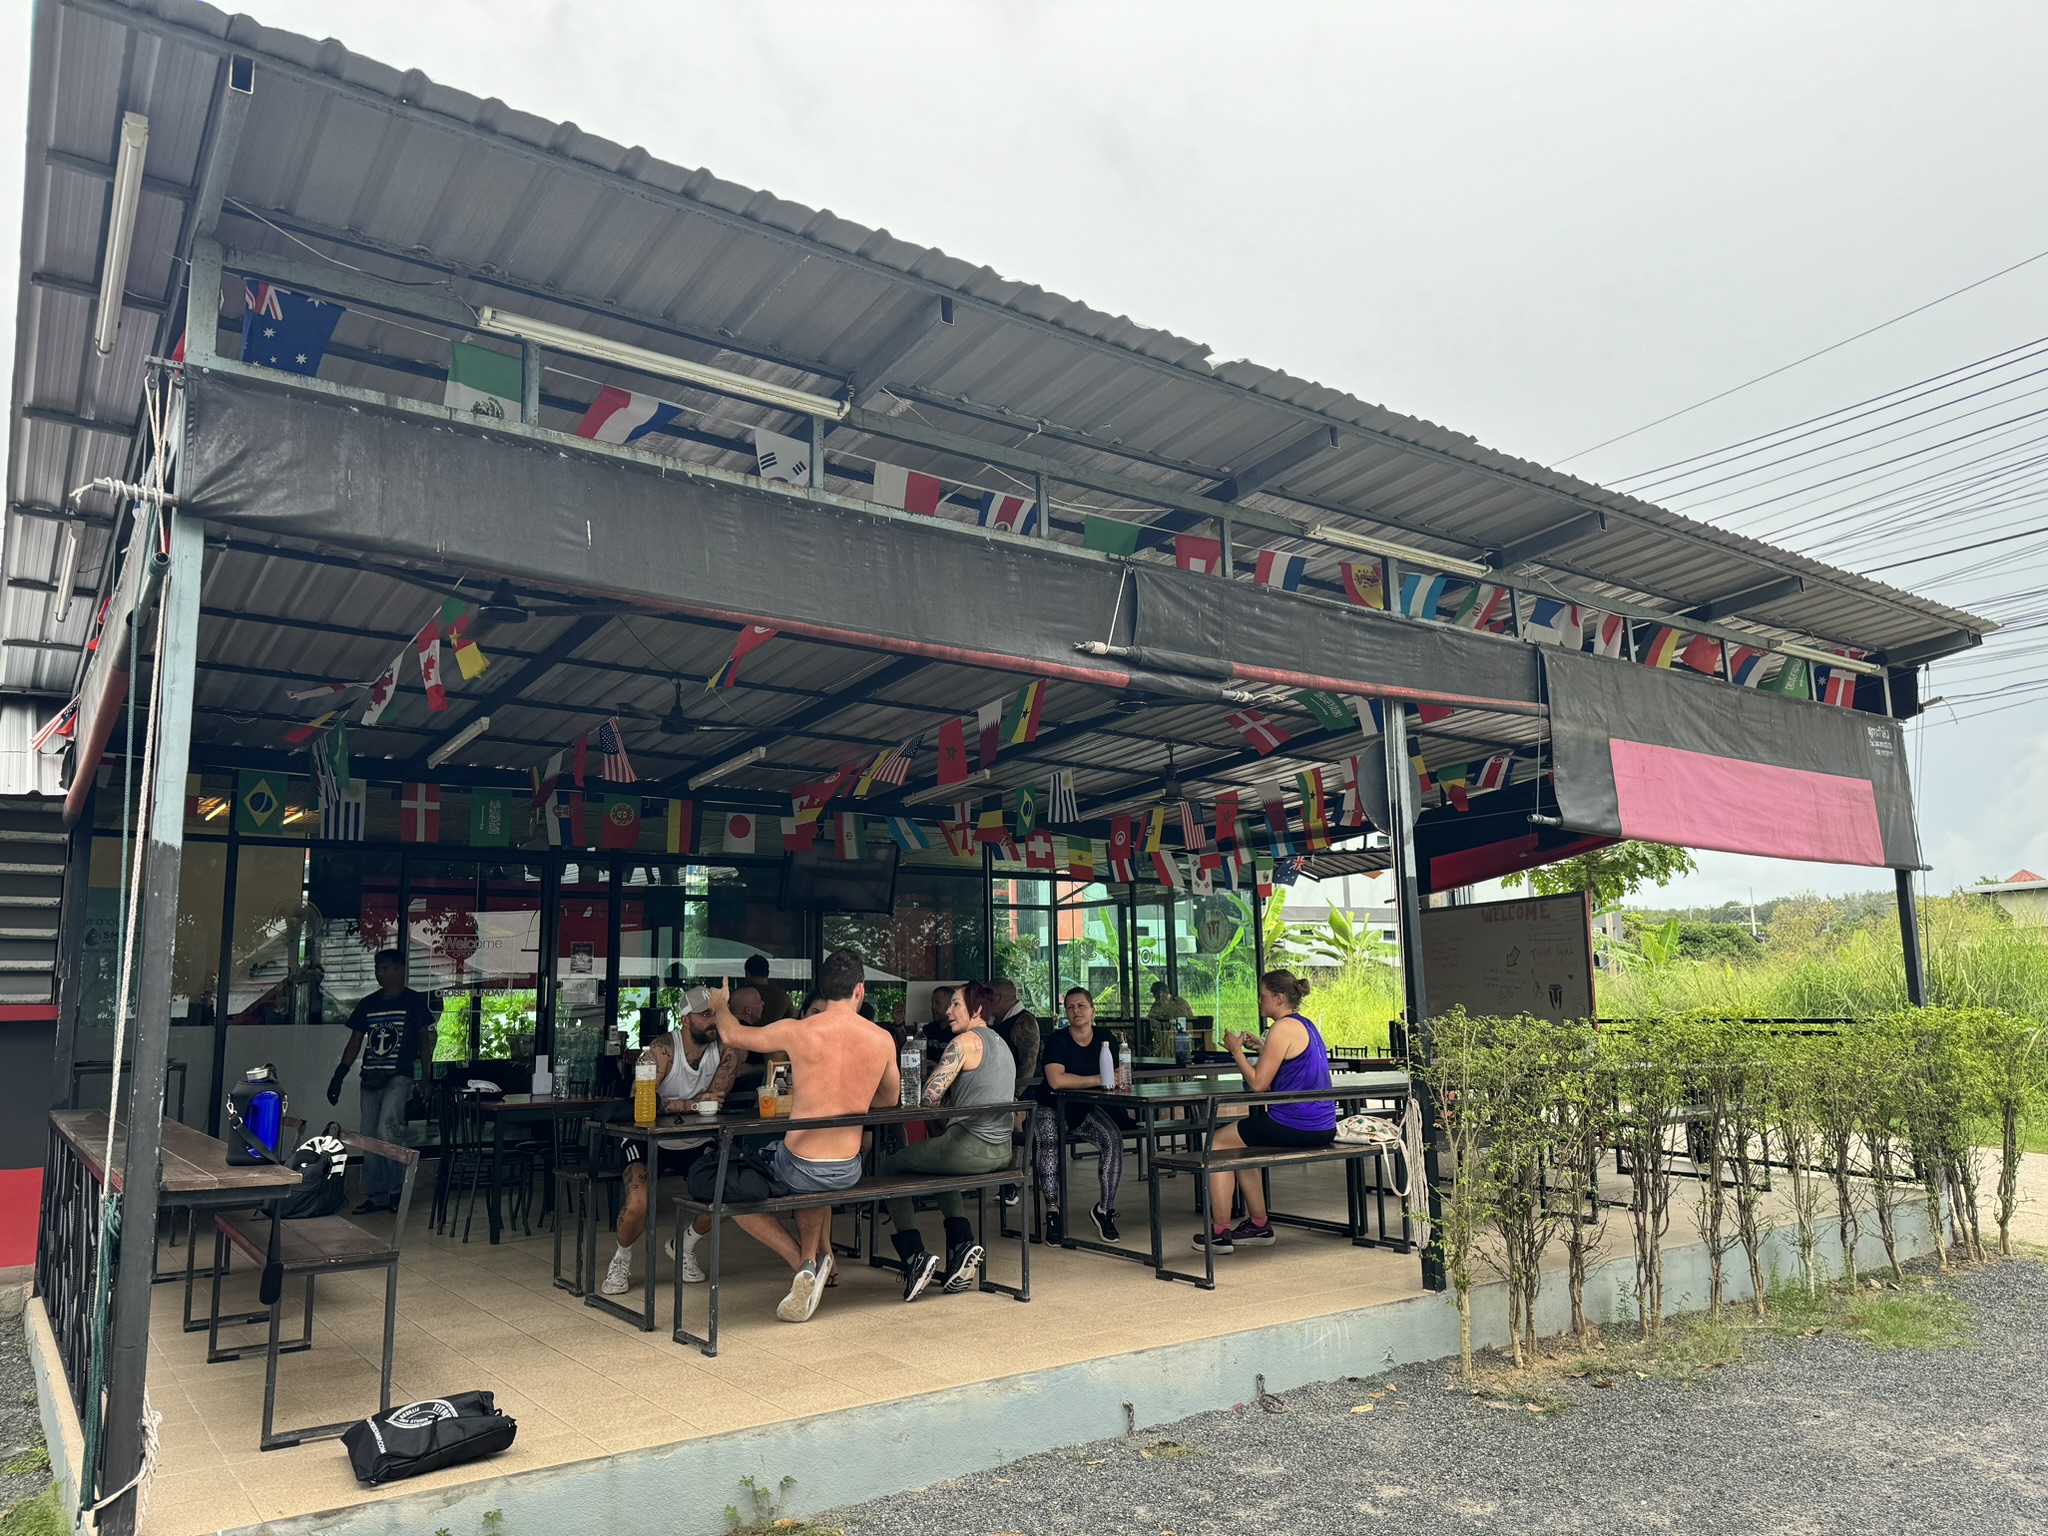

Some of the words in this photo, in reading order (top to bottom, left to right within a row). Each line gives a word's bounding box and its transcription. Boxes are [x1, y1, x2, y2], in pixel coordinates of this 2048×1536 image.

[1481, 902, 1551, 924] WELCOME
[443, 936, 503, 950] Welcome
[434, 988, 466, 998] CLOSE
